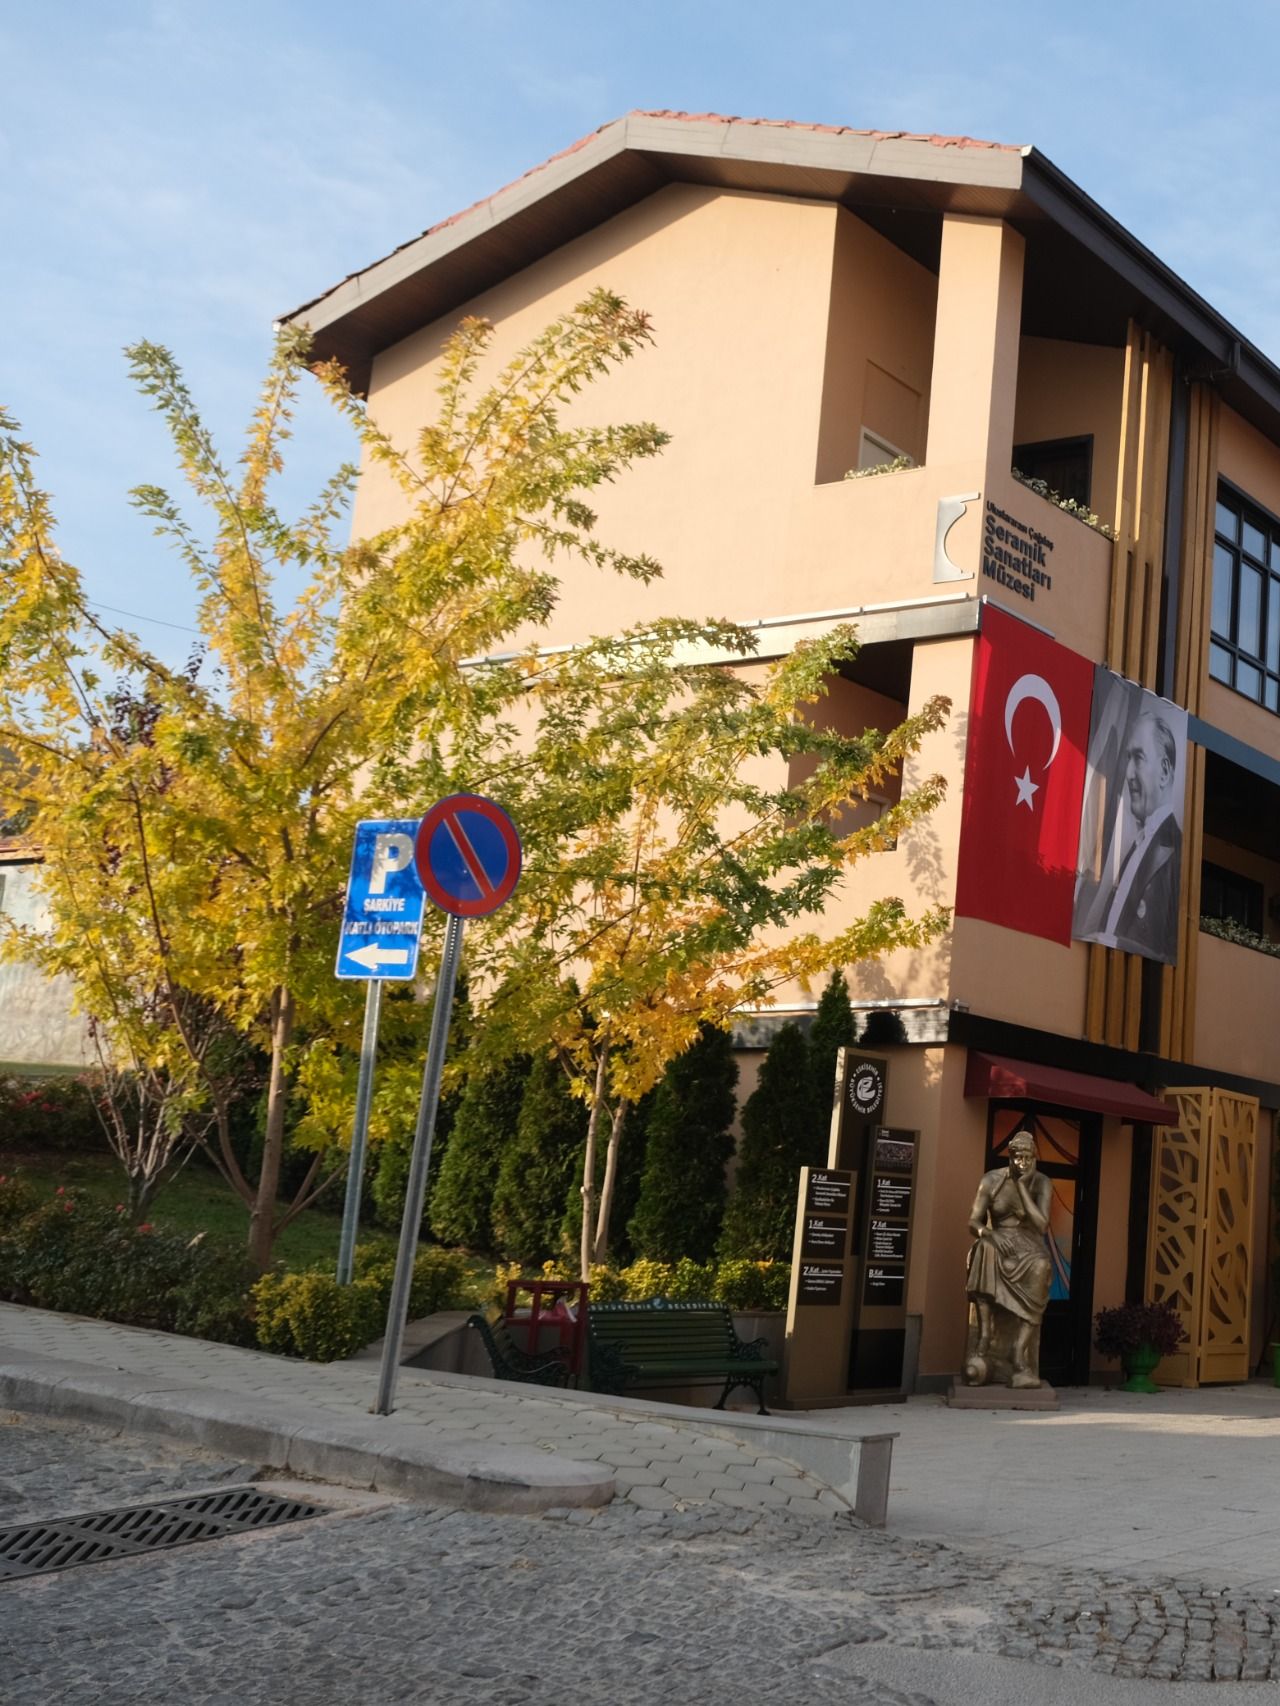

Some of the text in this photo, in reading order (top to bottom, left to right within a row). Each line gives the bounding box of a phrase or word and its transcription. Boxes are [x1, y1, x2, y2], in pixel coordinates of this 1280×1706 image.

[984, 534, 1051, 591] Sanatları
[985, 514, 1046, 567] Seramik
[983, 556, 1036, 602] Müzesi
[368, 833, 414, 894] P
